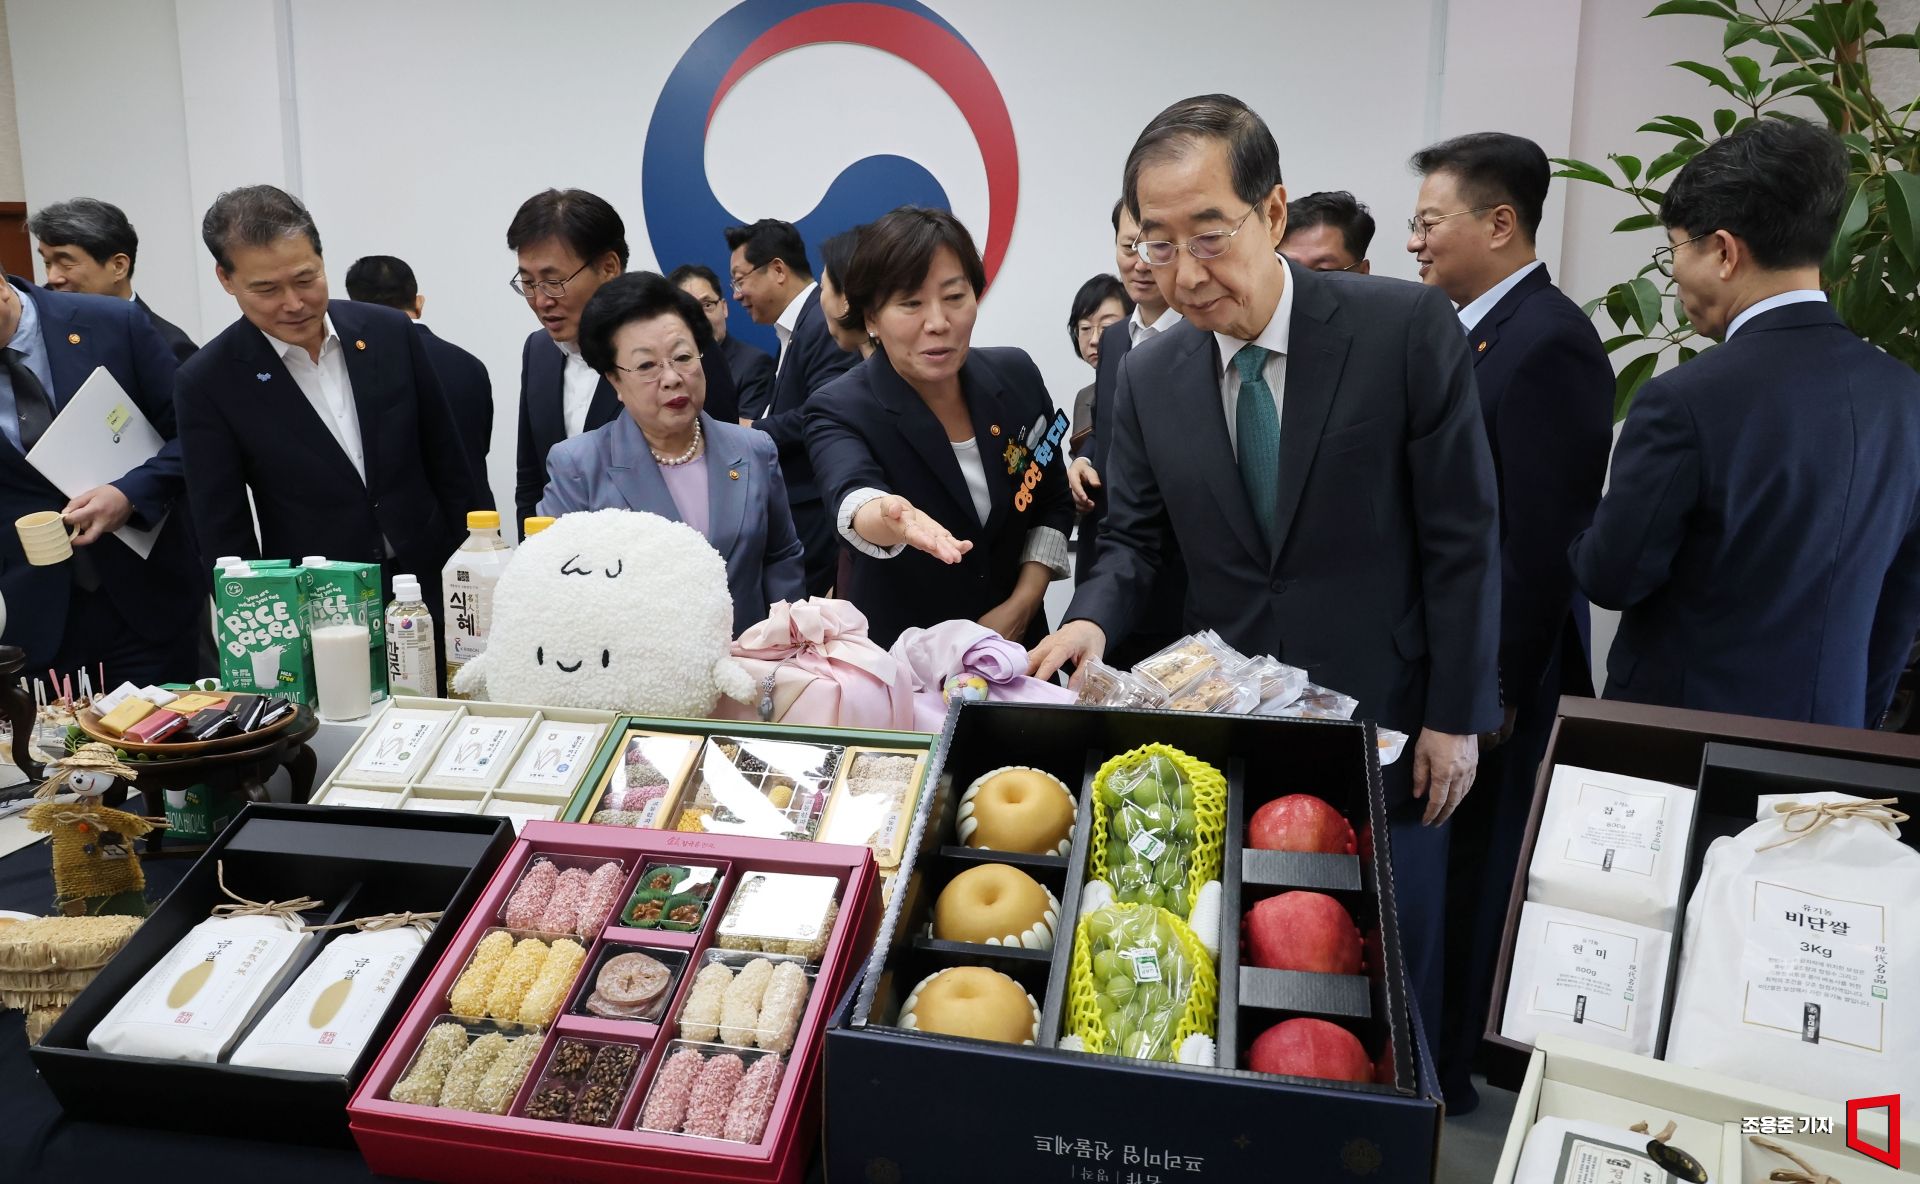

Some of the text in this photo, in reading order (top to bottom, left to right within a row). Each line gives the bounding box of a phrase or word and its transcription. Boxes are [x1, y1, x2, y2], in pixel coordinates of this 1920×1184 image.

[450, 592, 474, 636] 식혜
[227, 619, 300, 658] Based
[1785, 911, 1851, 936] 비단쌀
[1802, 904, 1833, 916] 유기농
[1800, 942, 1833, 958] 3Kg
[1874, 945, 1888, 985] 現代名品
[1033, 1135, 1205, 1172] 프리미엄 선물세트
